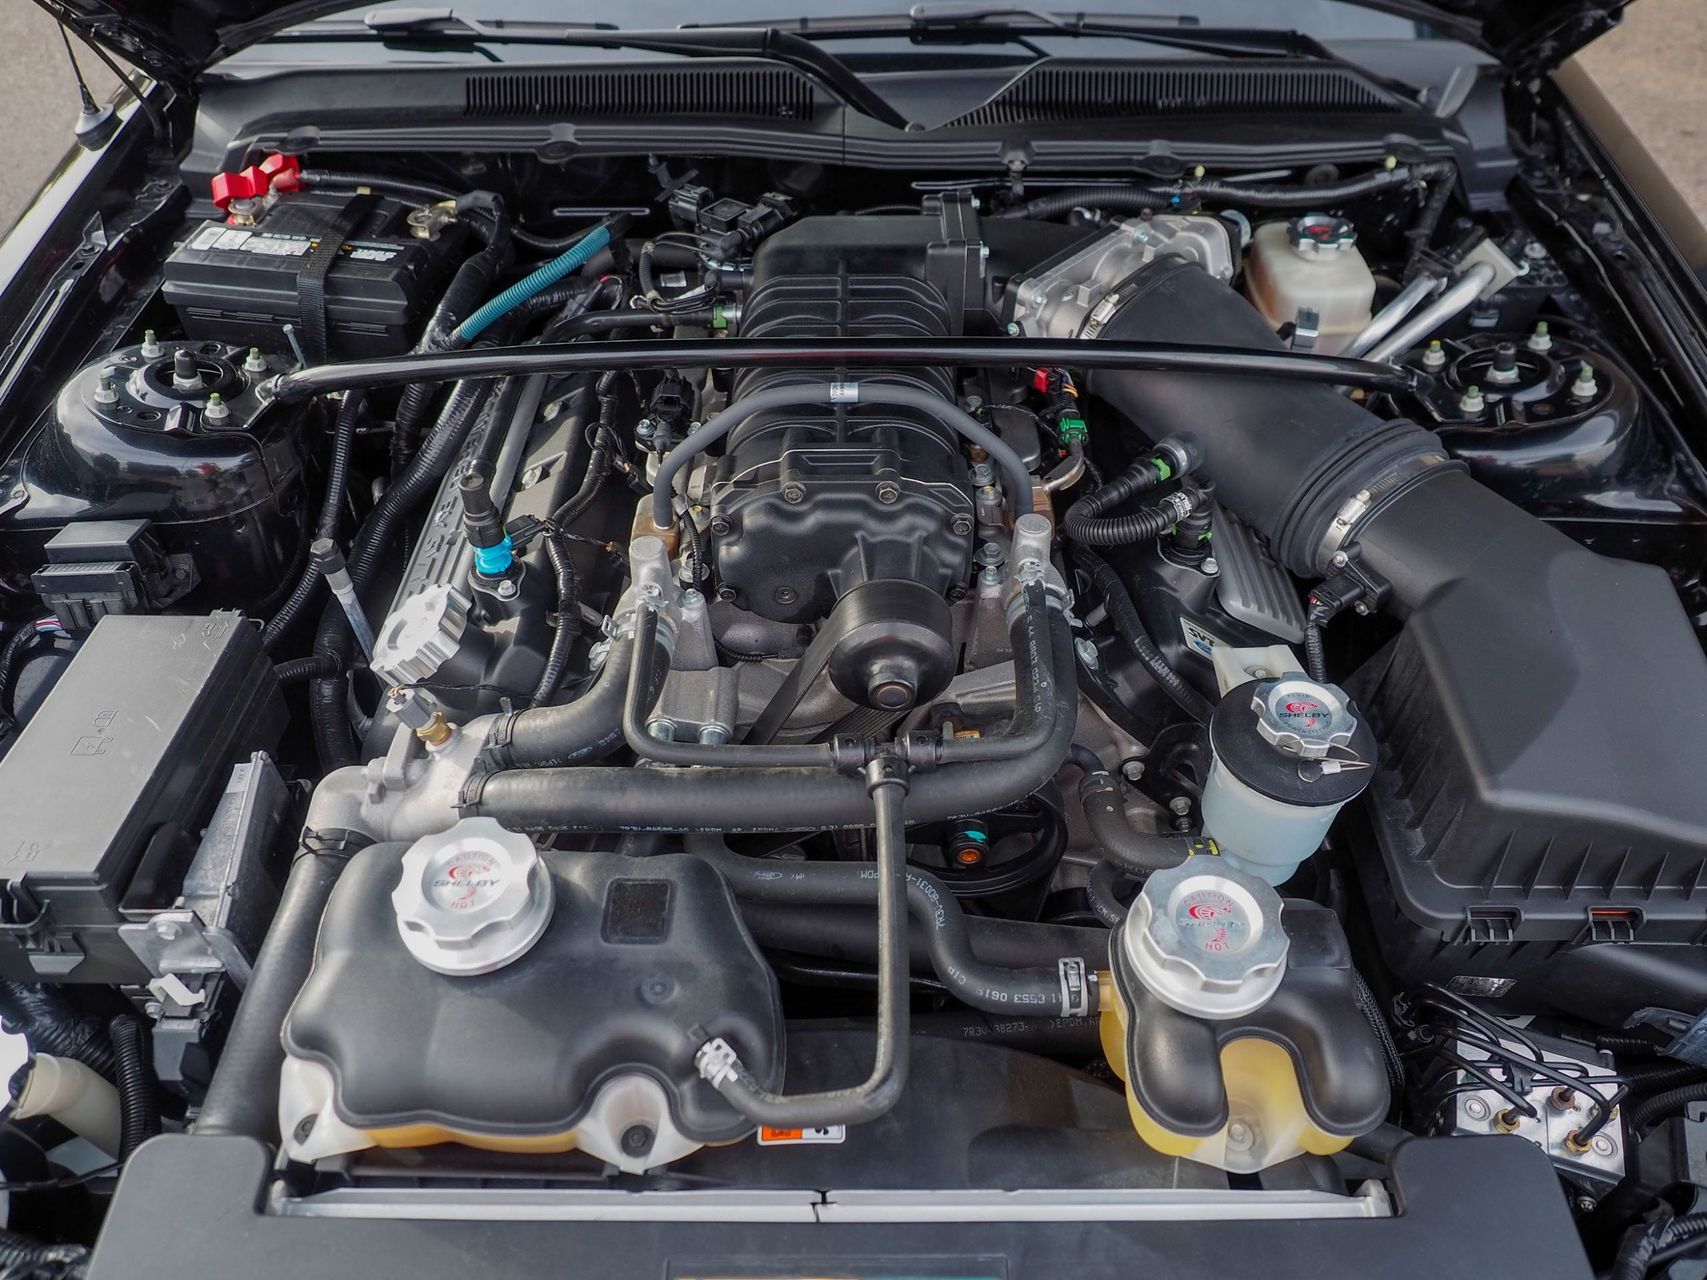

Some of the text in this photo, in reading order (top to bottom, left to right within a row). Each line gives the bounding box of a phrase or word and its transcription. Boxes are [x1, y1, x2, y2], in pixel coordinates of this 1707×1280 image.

[1188, 627, 1215, 647] SVT
[432, 879, 501, 887] SHELBY
[1183, 891, 1234, 906] CAUTION
[1205, 942, 1230, 952] HOT
